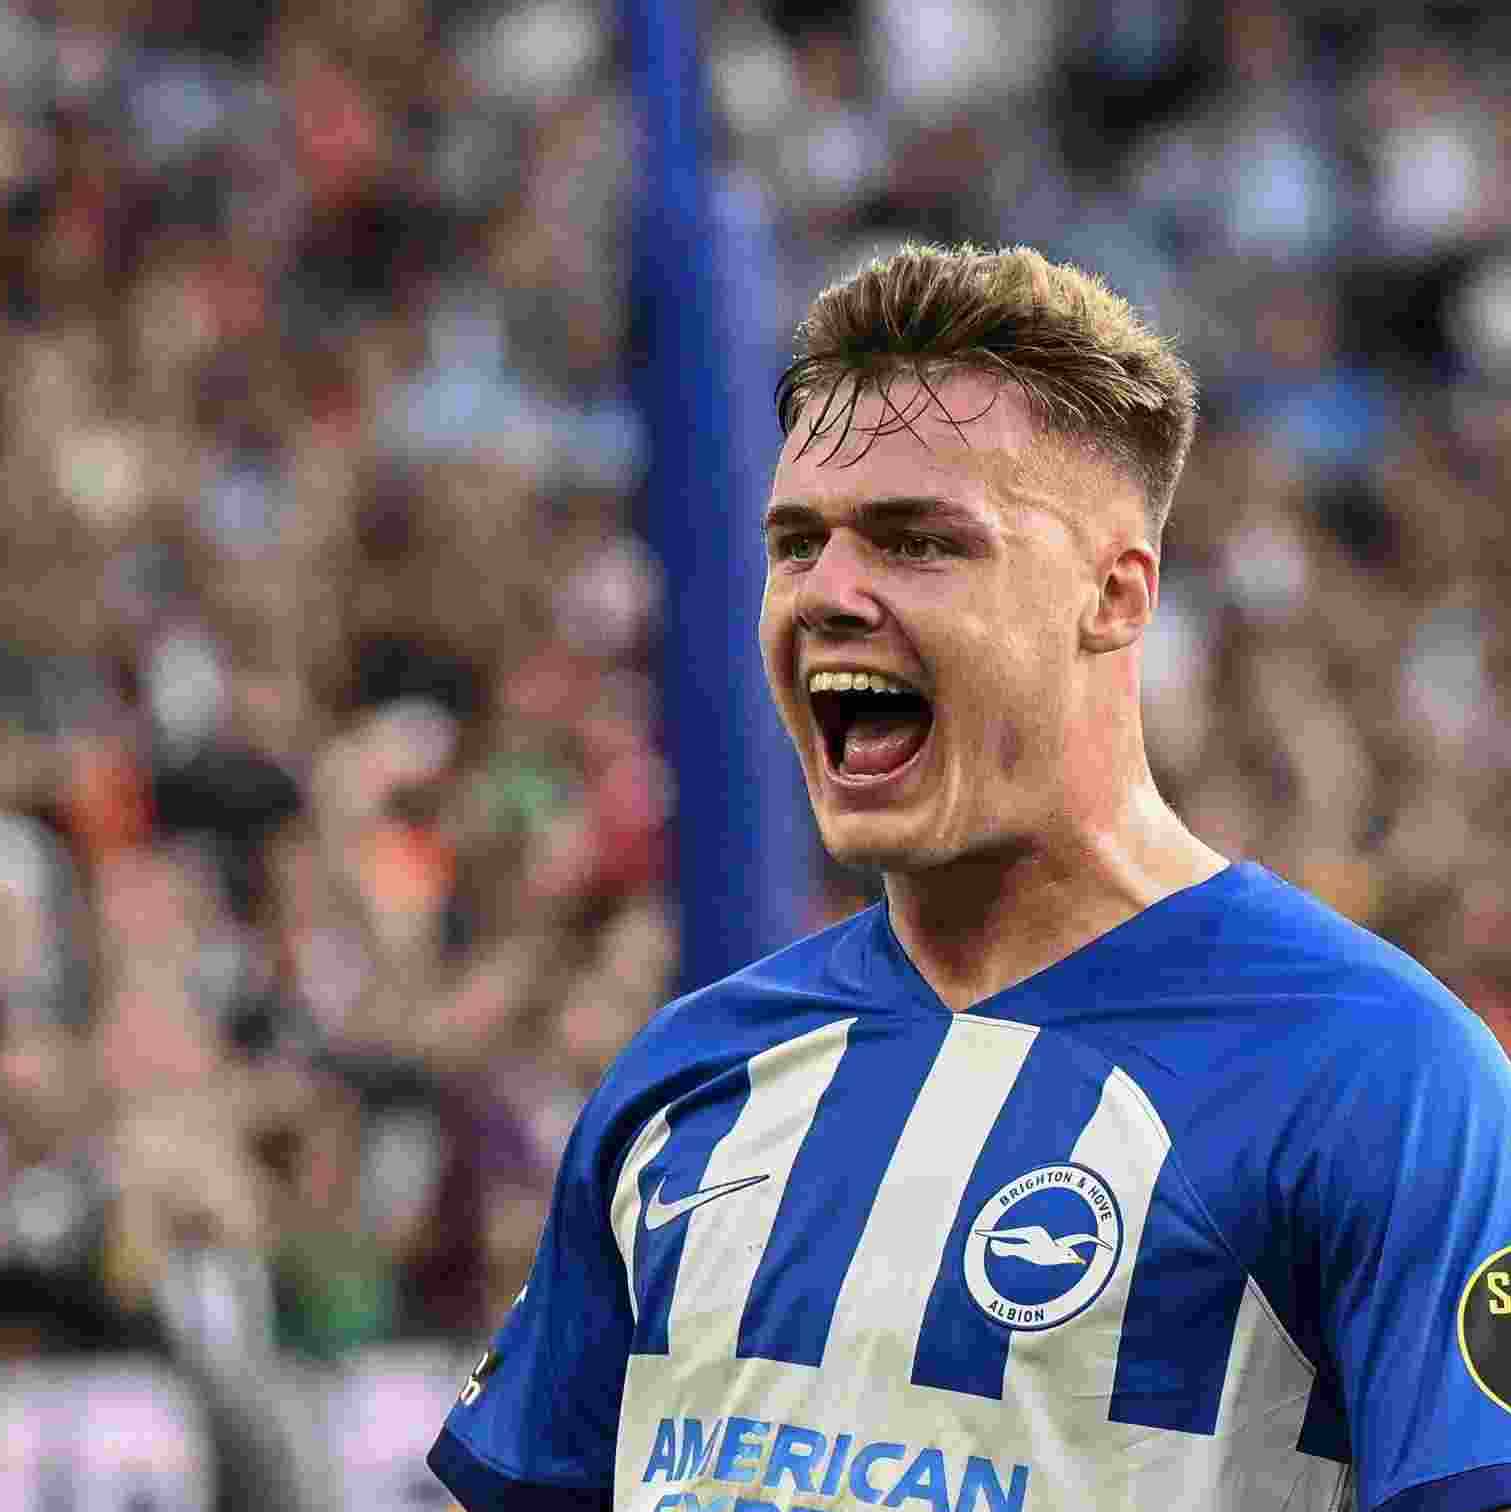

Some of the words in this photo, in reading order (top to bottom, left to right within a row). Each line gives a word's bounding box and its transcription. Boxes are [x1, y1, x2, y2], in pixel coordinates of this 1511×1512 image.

[999, 1170, 1073, 1207] BRIGHTON
[1088, 1184, 1113, 1223] HOVE
[988, 1300, 1045, 1323] ALBION
